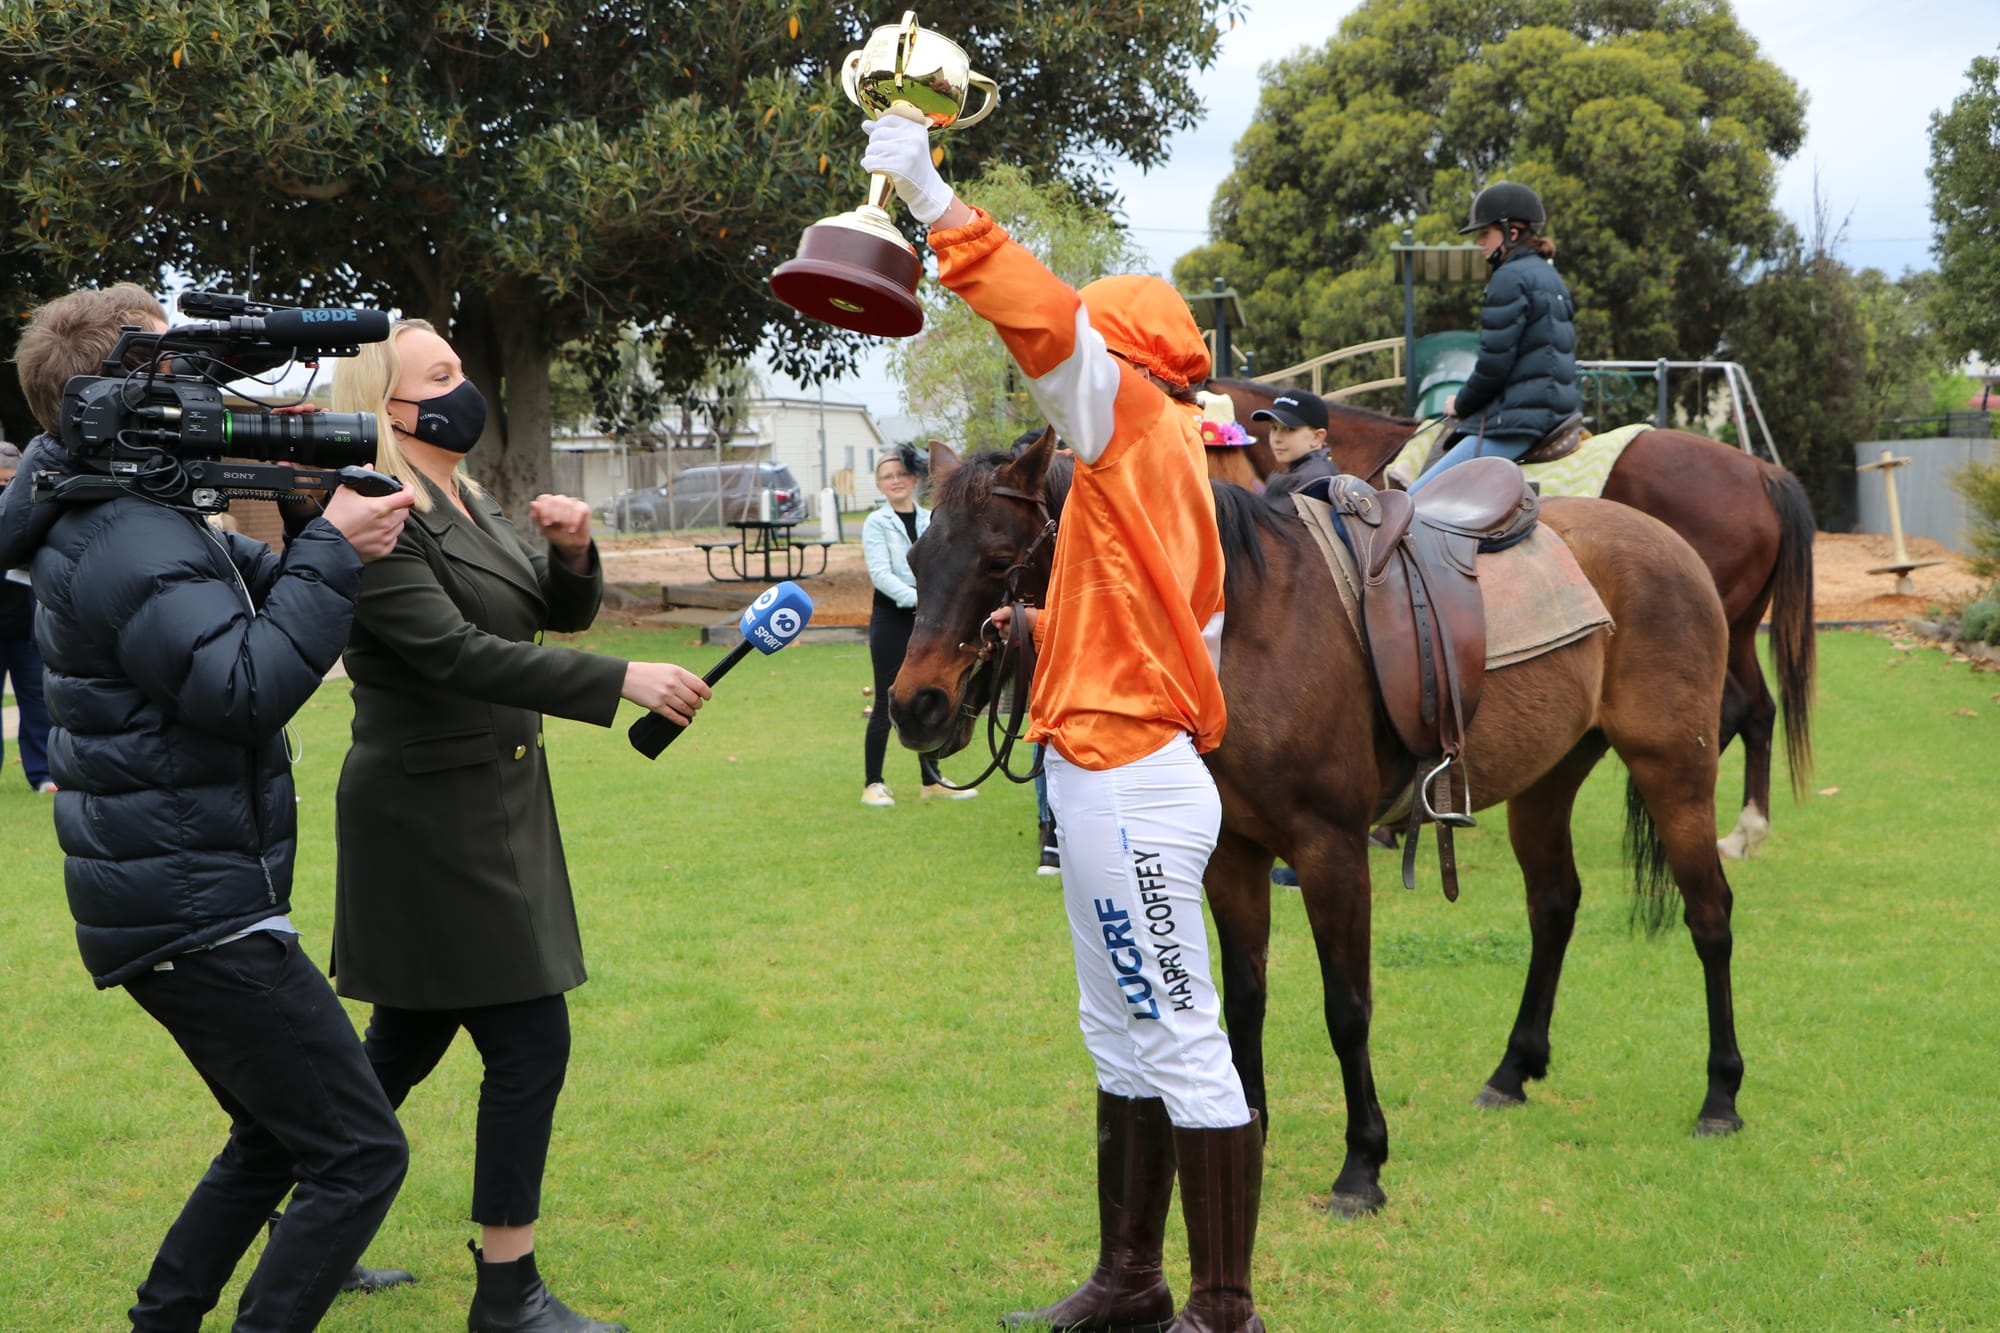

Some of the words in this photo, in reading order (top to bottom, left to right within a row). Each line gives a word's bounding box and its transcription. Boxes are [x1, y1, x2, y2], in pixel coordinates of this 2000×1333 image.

[301, 309, 357, 323] RØDE
[223, 471, 256, 480] SONY
[754, 625, 783, 650] SPORT
[1133, 849, 1175, 936] COFFEY
[1094, 898, 1161, 1020] LUCRF
[1154, 943, 1194, 1012] HARRY
